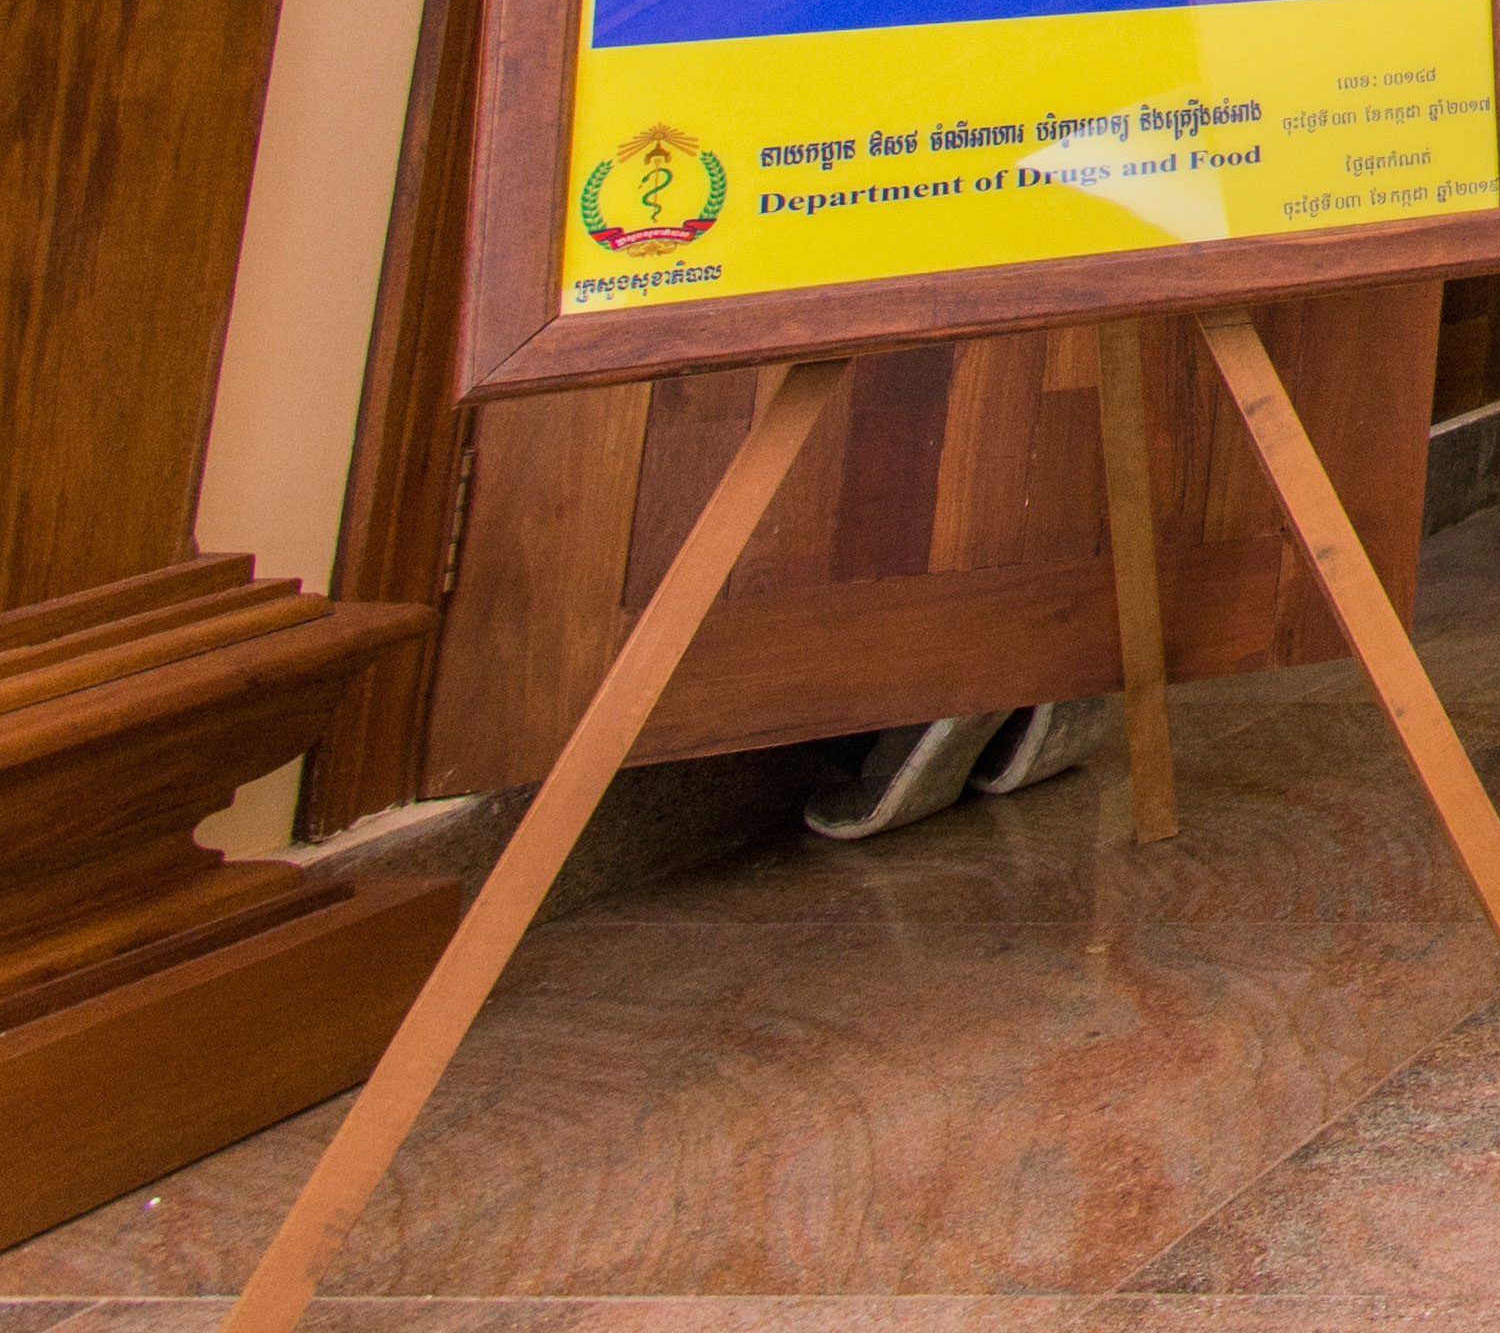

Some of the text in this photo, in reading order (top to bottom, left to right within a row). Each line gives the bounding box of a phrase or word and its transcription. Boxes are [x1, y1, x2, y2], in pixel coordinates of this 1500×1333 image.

[758, 145, 1262, 215] Department of Drugs and Food
